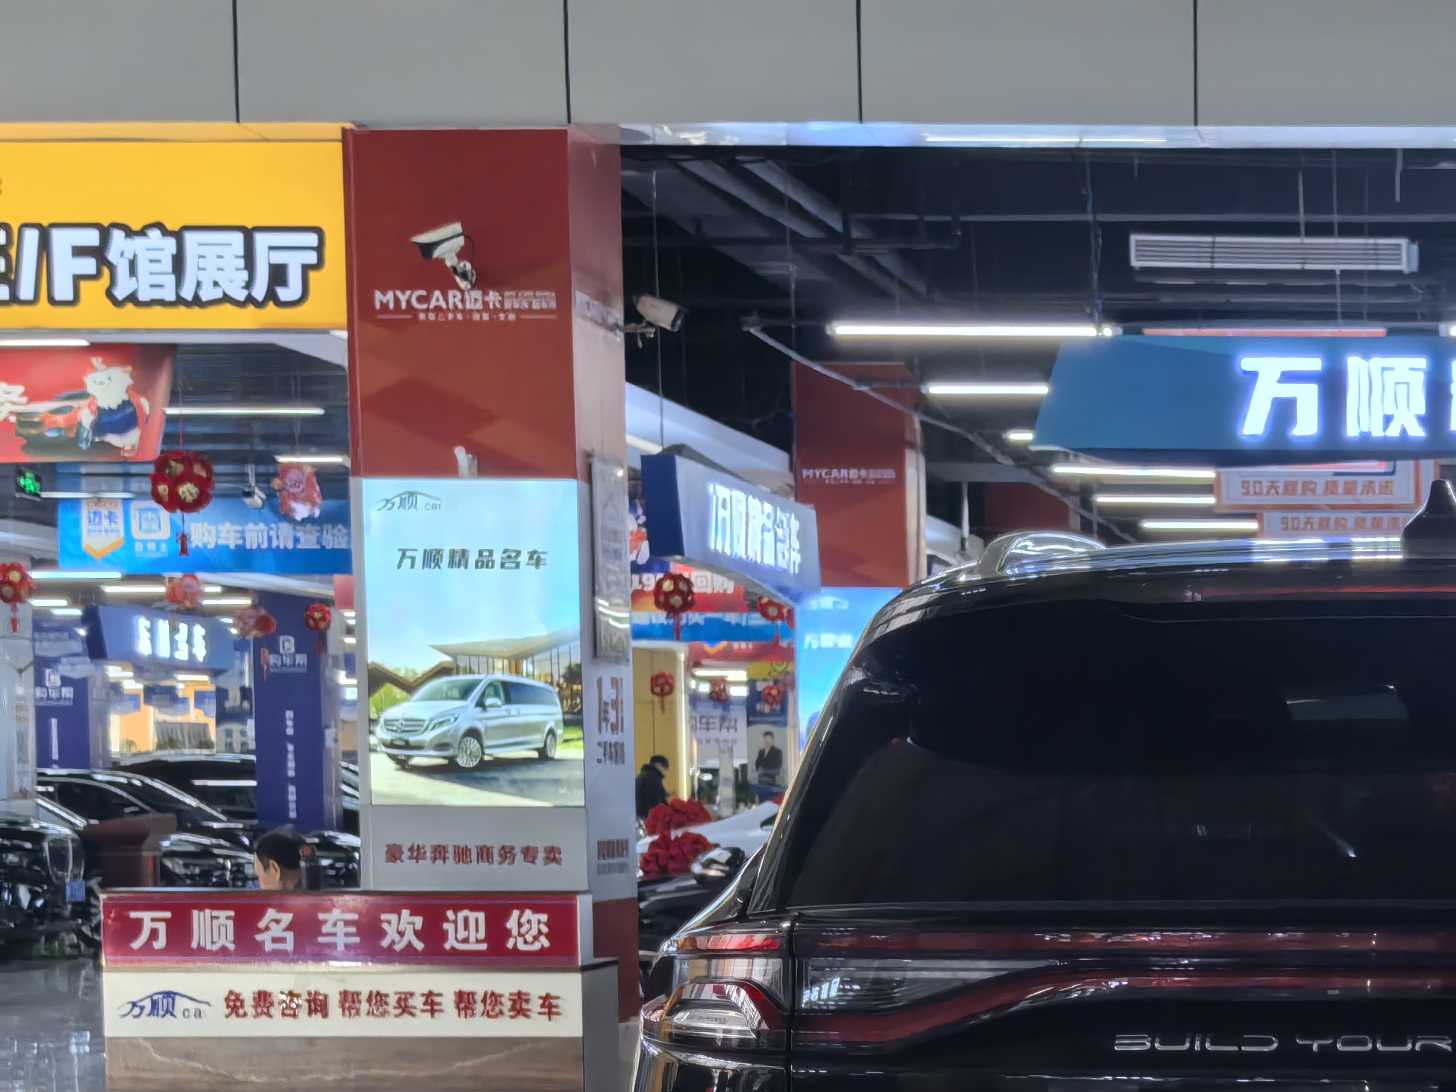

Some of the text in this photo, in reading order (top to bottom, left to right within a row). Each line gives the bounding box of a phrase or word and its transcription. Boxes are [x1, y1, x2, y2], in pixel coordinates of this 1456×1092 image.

[0, 225, 321, 304] /F馆展厅
[396, 547, 549, 571] 万顺精品名车
[128, 908, 551, 952] 万顺名车欢迎您
[223, 988, 330, 1020] 免费咨询
[454, 991, 563, 1022] 帮您卖车
[1113, 1033, 1279, 1052] BUILD
[1296, 1033, 1453, 1052] YOUR
